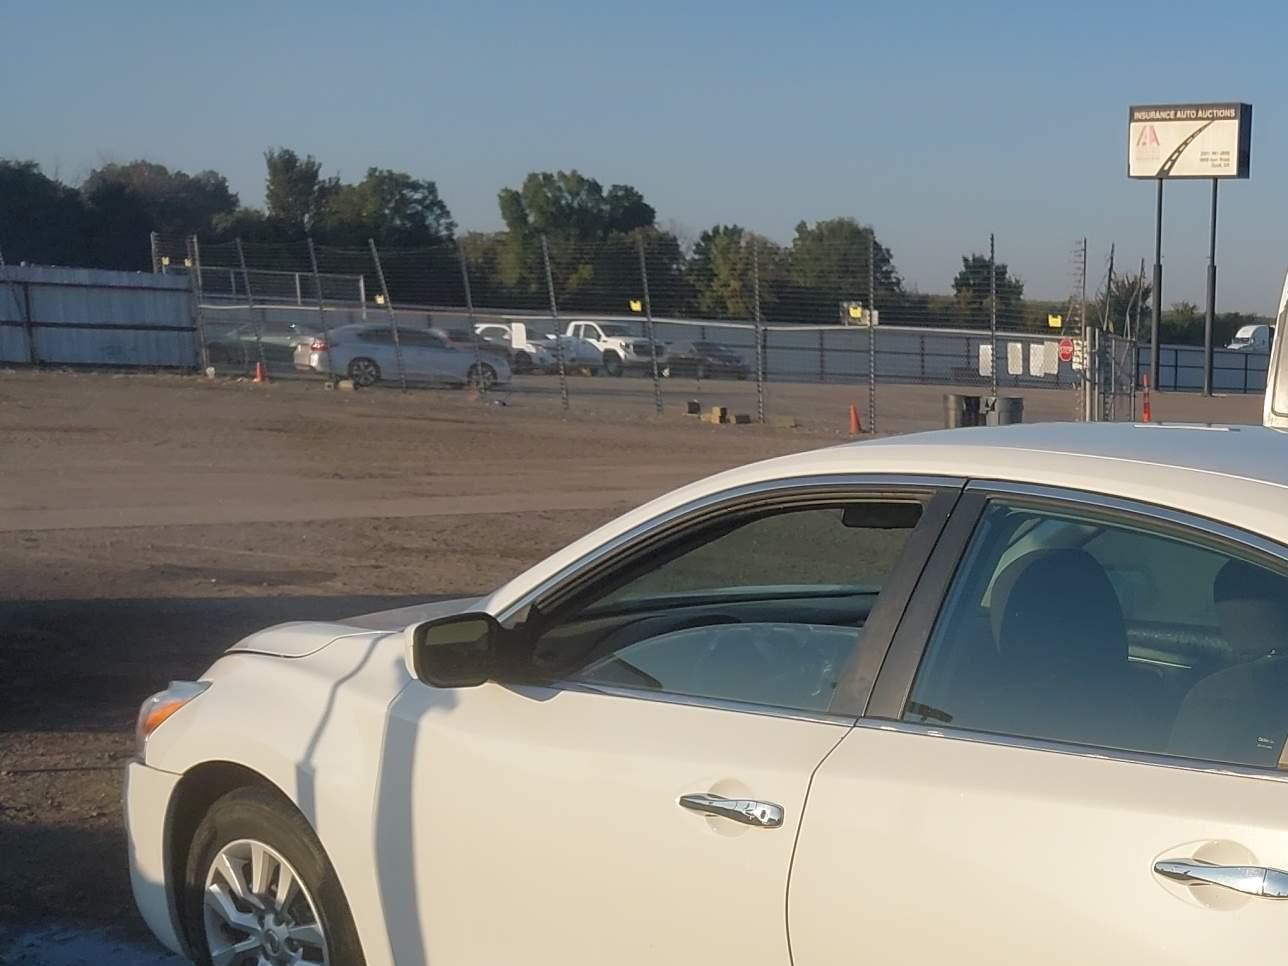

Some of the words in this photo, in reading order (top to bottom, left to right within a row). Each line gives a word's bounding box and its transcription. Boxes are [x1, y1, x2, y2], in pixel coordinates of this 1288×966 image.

[1134, 110, 1175, 120] INSURANCE
[1176, 109, 1197, 119] AUTO
[1197, 108, 1236, 118] AUCTIONS
